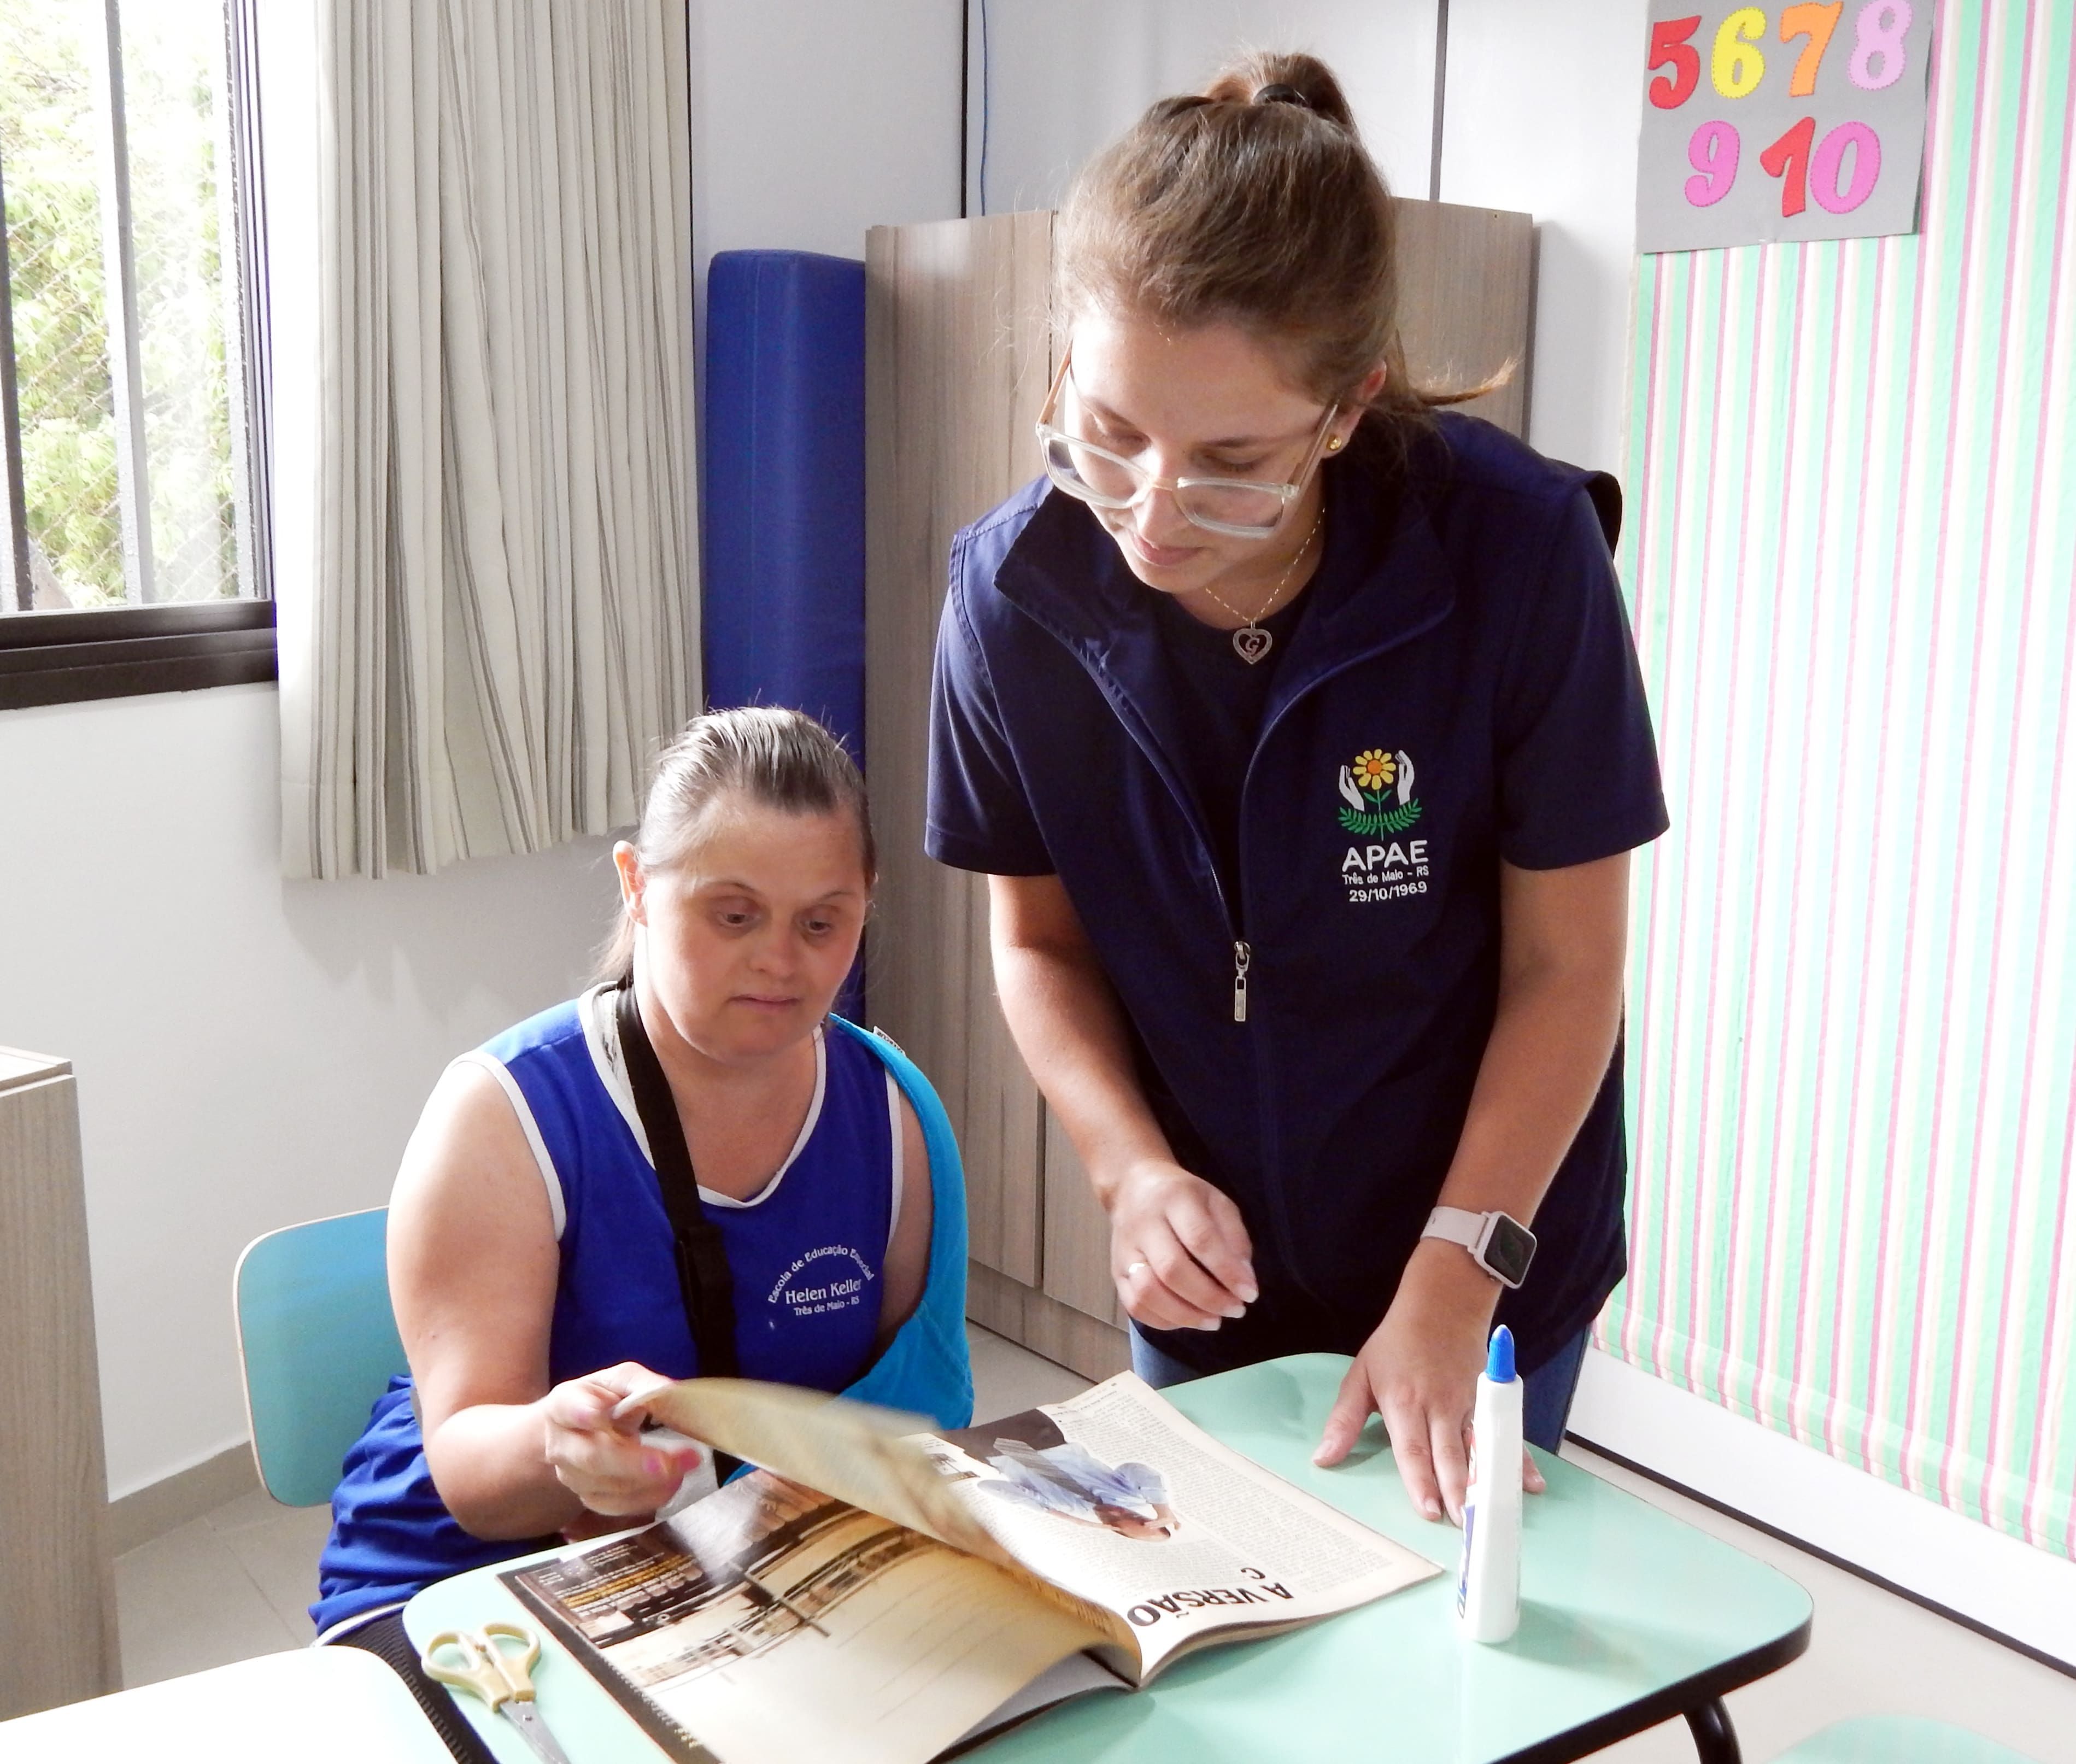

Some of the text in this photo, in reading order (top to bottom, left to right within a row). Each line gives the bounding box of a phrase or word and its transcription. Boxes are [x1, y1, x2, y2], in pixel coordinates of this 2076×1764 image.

[1647, 0, 1913, 109] 5 6 7 8
[1684, 116, 1881, 218] 9 10
[1342, 840, 1429, 872] APAE
[1342, 872, 1364, 885] Três
[1367, 872, 1378, 883] de
[1382, 869, 1403, 883] Maio
[1416, 865, 1429, 877] RS
[1349, 881, 1427, 902] 29/10/1969
[767, 1271, 791, 1304] Escola
[791, 1259, 805, 1272] de
[805, 1244, 848, 1262] Educação
[785, 1279, 862, 1304] Helen Keller
[794, 1305, 812, 1316] Três
[814, 1304, 825, 1313] de
[827, 1300, 845, 1311] Maio
[1127, 1583, 1294, 1626] A VERSÃO
